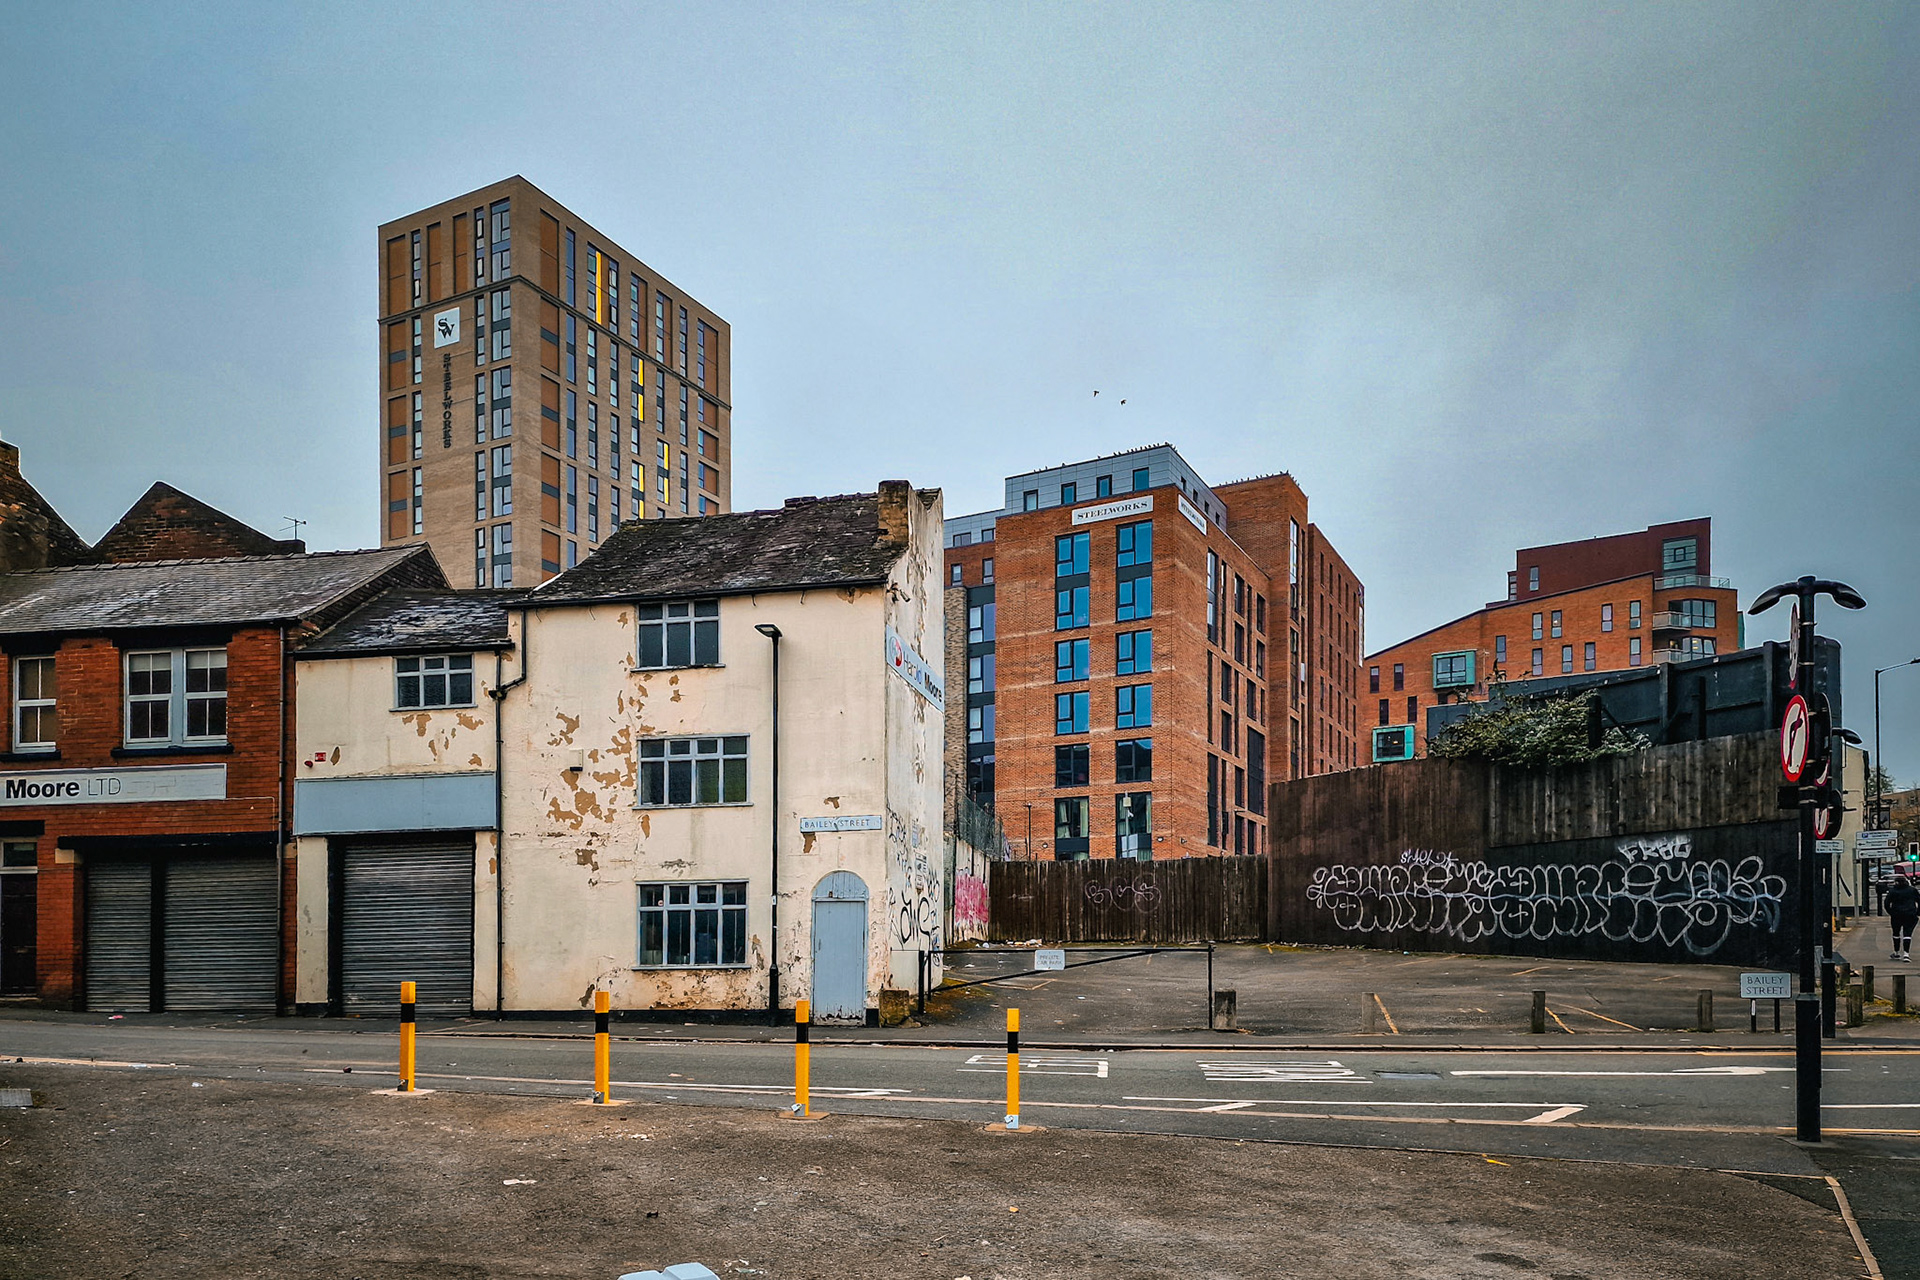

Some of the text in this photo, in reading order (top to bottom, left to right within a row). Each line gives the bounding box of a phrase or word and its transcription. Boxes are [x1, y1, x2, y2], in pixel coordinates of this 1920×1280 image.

[442, 353, 453, 448] STEELWORKS
[1077, 500, 1148, 520] STEELWORKS
[6, 777, 122, 799] Moore LTD
[804, 819, 833, 828] BAILEY
[839, 818, 870, 827] STREET
[1747, 976, 1784, 985] BAILEY
[1745, 986, 1785, 995] STREET
